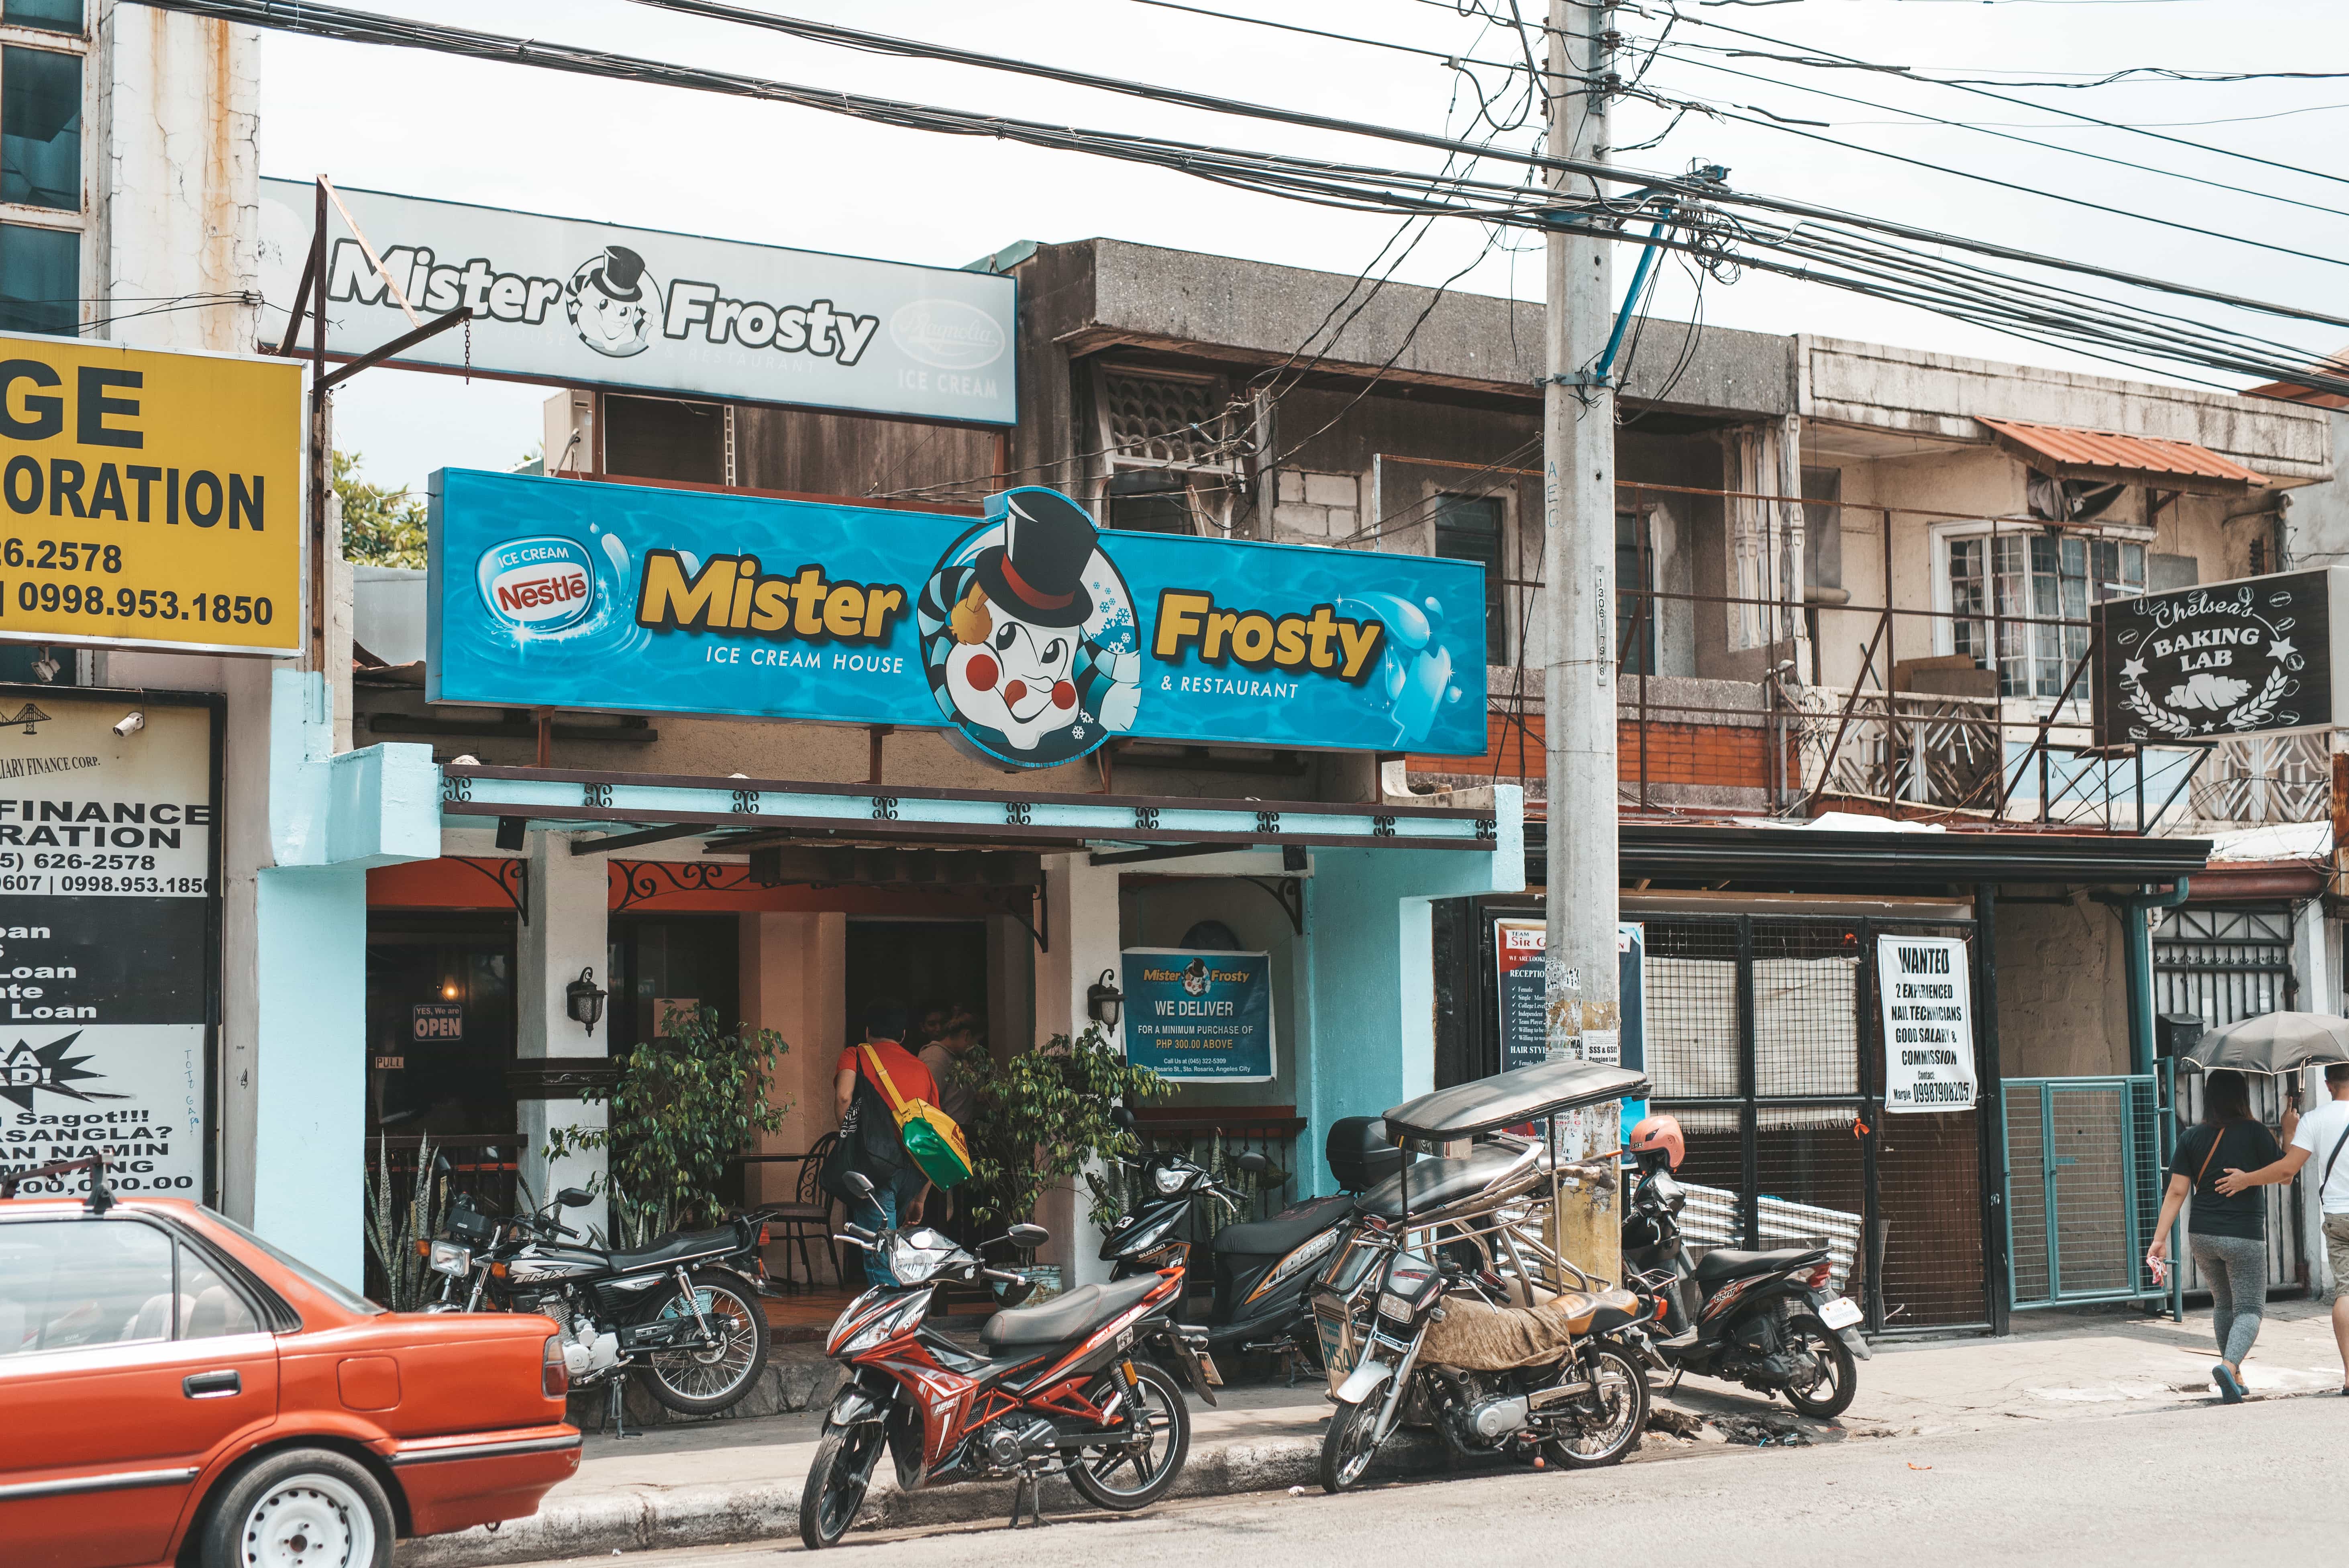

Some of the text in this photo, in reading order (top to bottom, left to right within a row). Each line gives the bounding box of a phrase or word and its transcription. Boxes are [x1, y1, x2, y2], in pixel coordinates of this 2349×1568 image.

[326, 238, 879, 366] Mister Frosty
[689, 347, 816, 373] RESTAURANT
[898, 369, 998, 399] ICE CREAM
[4, 455, 264, 531] ORATION
[0, 538, 122, 573] 6.2578
[498, 547, 570, 569] ICE CREAM
[19, 582, 272, 625] 0998.953.1850
[635, 548, 1385, 683] Mister Frosty
[2153, 627, 2259, 658] BAKING
[707, 646, 903, 673] ICE CREAM HOUSE
[2180, 649, 2233, 672] LAB
[1161, 675, 1298, 699] & RESTAURANT
[25, 757, 71, 775] FINANCE
[72, 756, 100, 769] CORP.
[34, 853, 155, 871] 626-2578
[0, 875, 42, 891] 607
[1898, 948, 1949, 974] WANTED
[1144, 969, 1250, 983] Mister Frosty
[1510, 969, 1545, 978] RECEPTIO
[1896, 983, 1953, 999] 2 EXPERIENCED
[12, 1003, 96, 1019] Loan
[416, 1007, 433, 1015] YES,
[1155, 1001, 1234, 1016] WE DELIVER
[1892, 1006, 1962, 1021] NAIL TECHNICIANS
[416, 1018, 460, 1037] OPEN
[1138, 1025, 1253, 1034] FOR A MINIMUM PURCHASE OF
[1896, 1028, 1957, 1043] GOOD SALARY &
[1156, 1039, 1233, 1049] PHP 300.00 ABOVE
[1511, 1046, 1527, 1054] HAIR
[377, 1057, 402, 1068] PULL
[1902, 1050, 1957, 1066] COMMISSION
[1894, 1082, 1970, 1103] Margie 09987908205
[16, 1109, 149, 1127] Sagot!!!
[0, 1126, 173, 1144] SANGLA?
[1138, 1243, 1166, 1260] SUZUKI
[511, 1266, 572, 1284] TMX
[1380, 1336, 1399, 1347] HONDA
